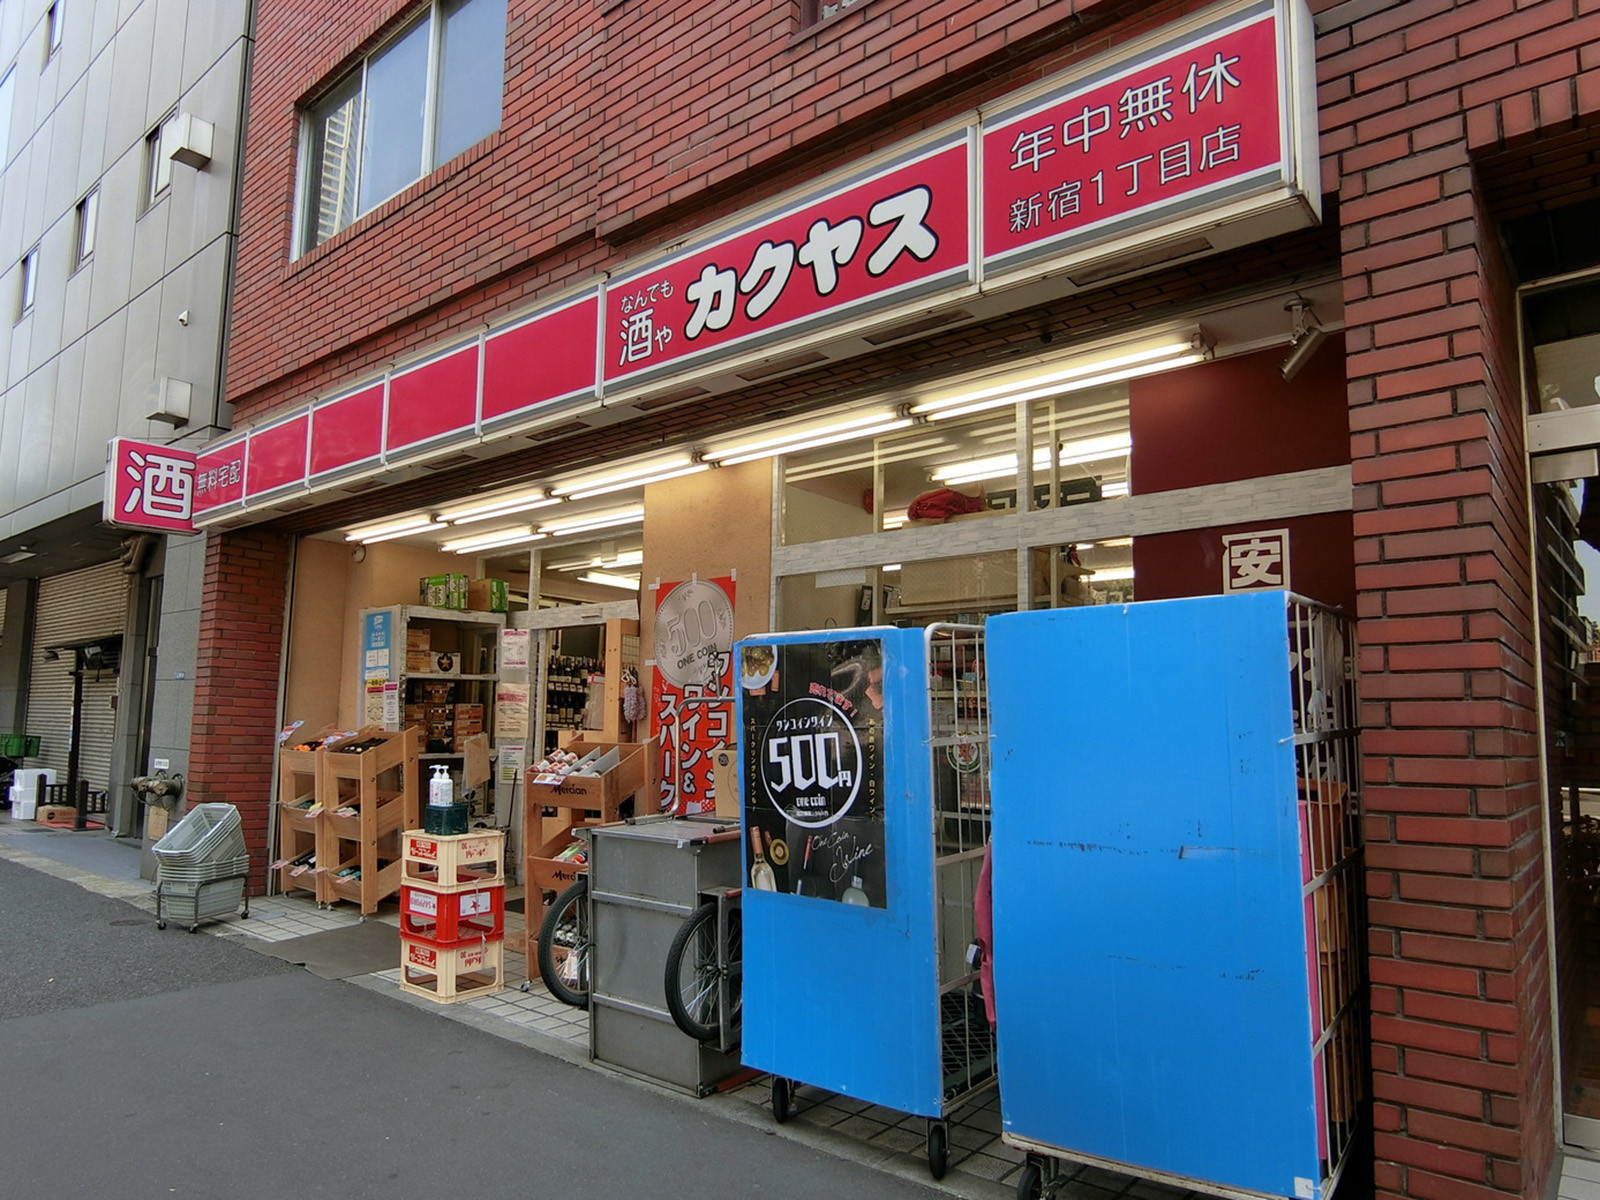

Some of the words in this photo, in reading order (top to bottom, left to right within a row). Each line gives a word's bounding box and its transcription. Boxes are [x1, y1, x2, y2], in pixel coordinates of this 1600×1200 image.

[1010, 52, 1240, 173] 年中無休
[1009, 124, 1241, 233] 新宿1丁目店
[684, 184, 940, 340] カクヤス
[620, 279, 674, 313] なんでも
[124, 450, 196, 520] 酒
[196, 459, 241, 496] 無料宅配
[1230, 538, 1281, 588] 安
[667, 600, 717, 657] 500
[677, 654, 696, 670] ONE
[697, 643, 717, 658] COIN
[776, 715, 833, 732] ワンコインワイン
[550, 784, 587, 796] Mercian
